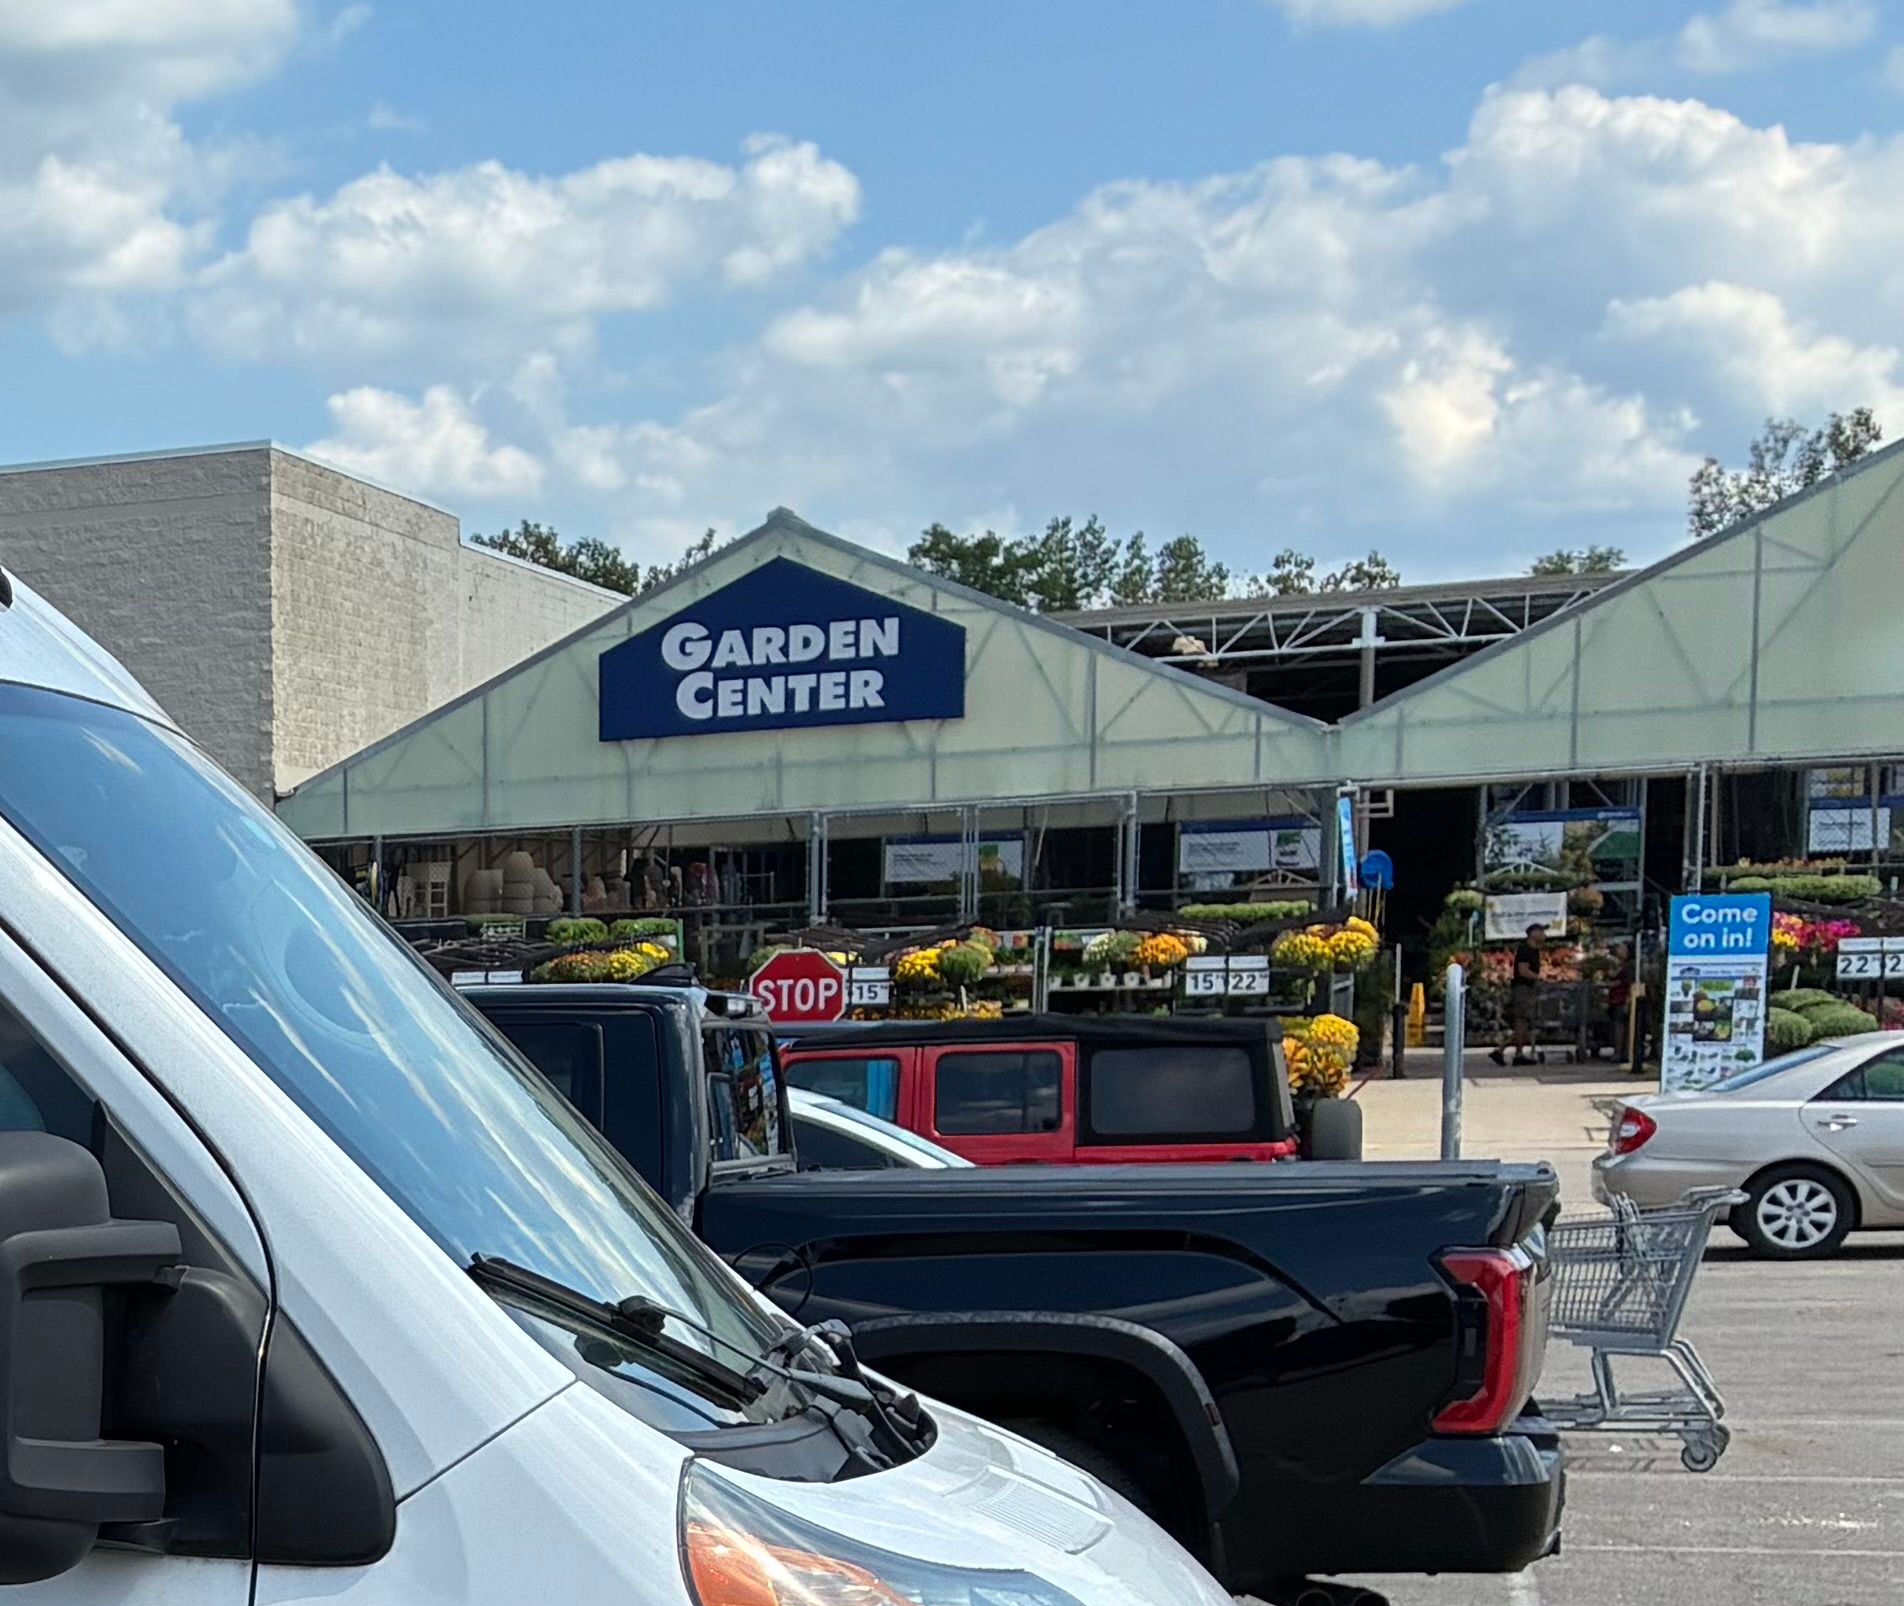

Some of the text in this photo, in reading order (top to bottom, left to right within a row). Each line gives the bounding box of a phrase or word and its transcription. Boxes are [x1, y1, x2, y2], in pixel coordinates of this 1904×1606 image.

[661, 617, 900, 671] GARDEN
[675, 669, 885, 720] CENTER
[1681, 903, 1758, 924] Come
[1683, 927, 1753, 948] on in!
[1889, 955, 1903, 973] 2
[758, 978, 838, 1012] STOP
